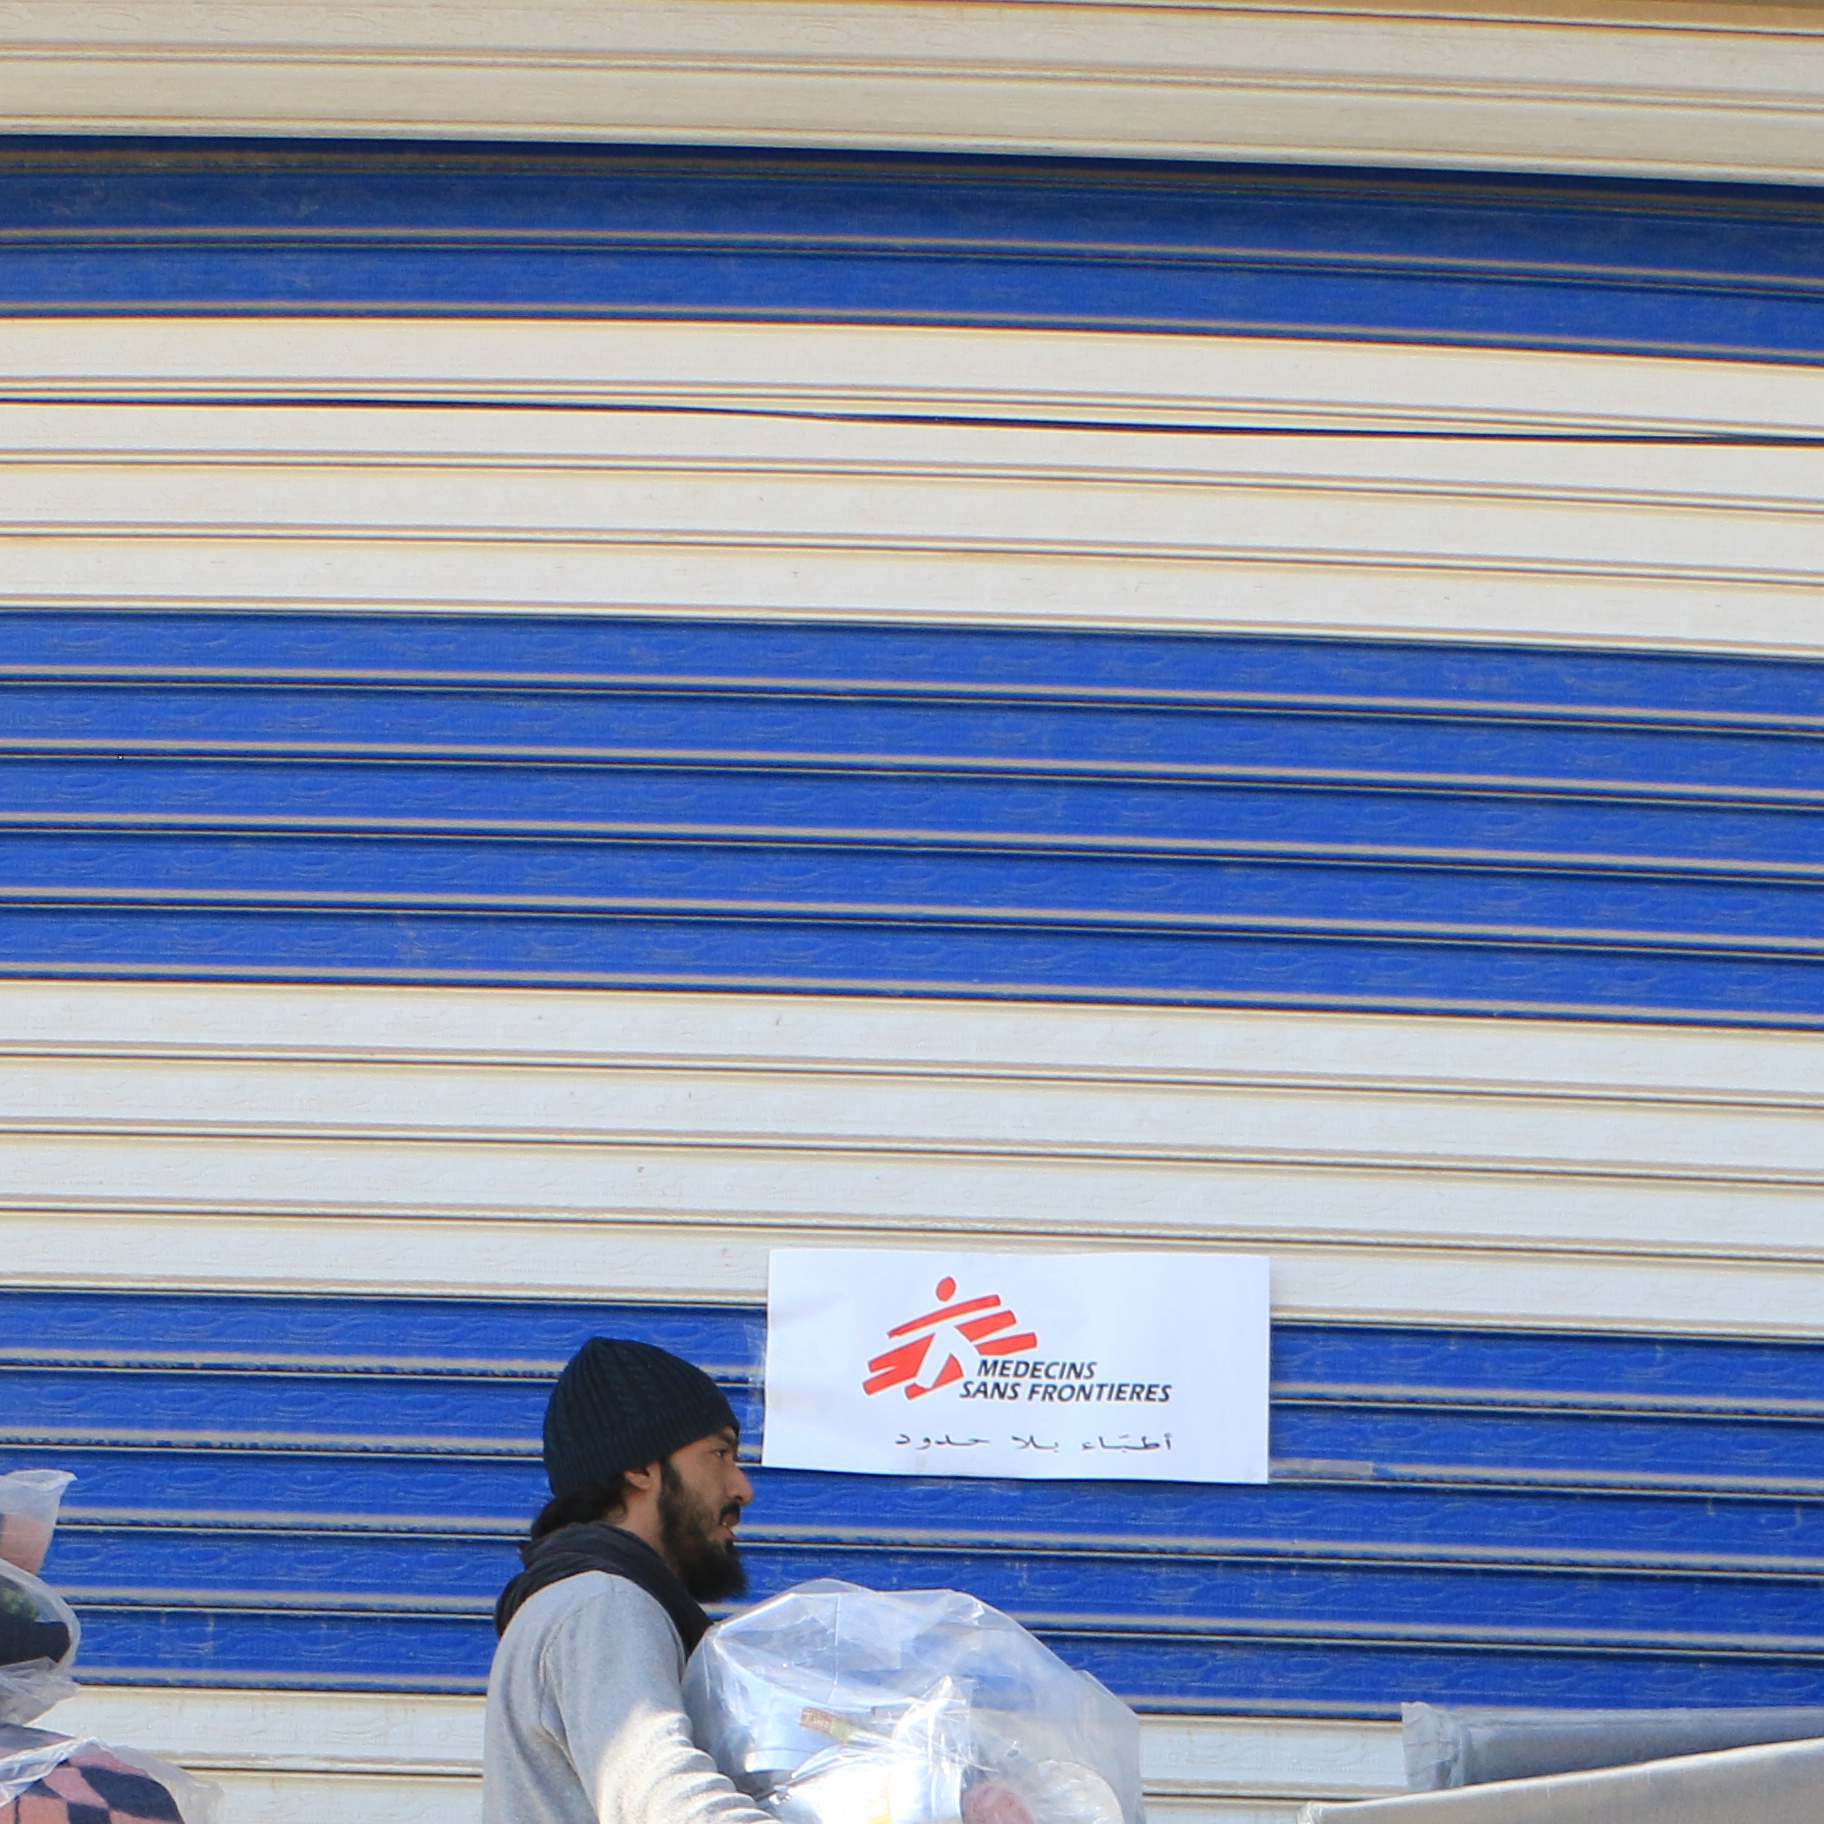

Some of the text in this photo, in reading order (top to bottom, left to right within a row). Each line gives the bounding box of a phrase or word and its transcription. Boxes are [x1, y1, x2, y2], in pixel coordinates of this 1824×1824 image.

[977, 1359, 1097, 1380] MEDECINS
[960, 1381, 1172, 1402] SANS FRONTIERES
[895, 1433, 990, 1450] حدود
[1011, 1434, 1059, 1453] بلا
